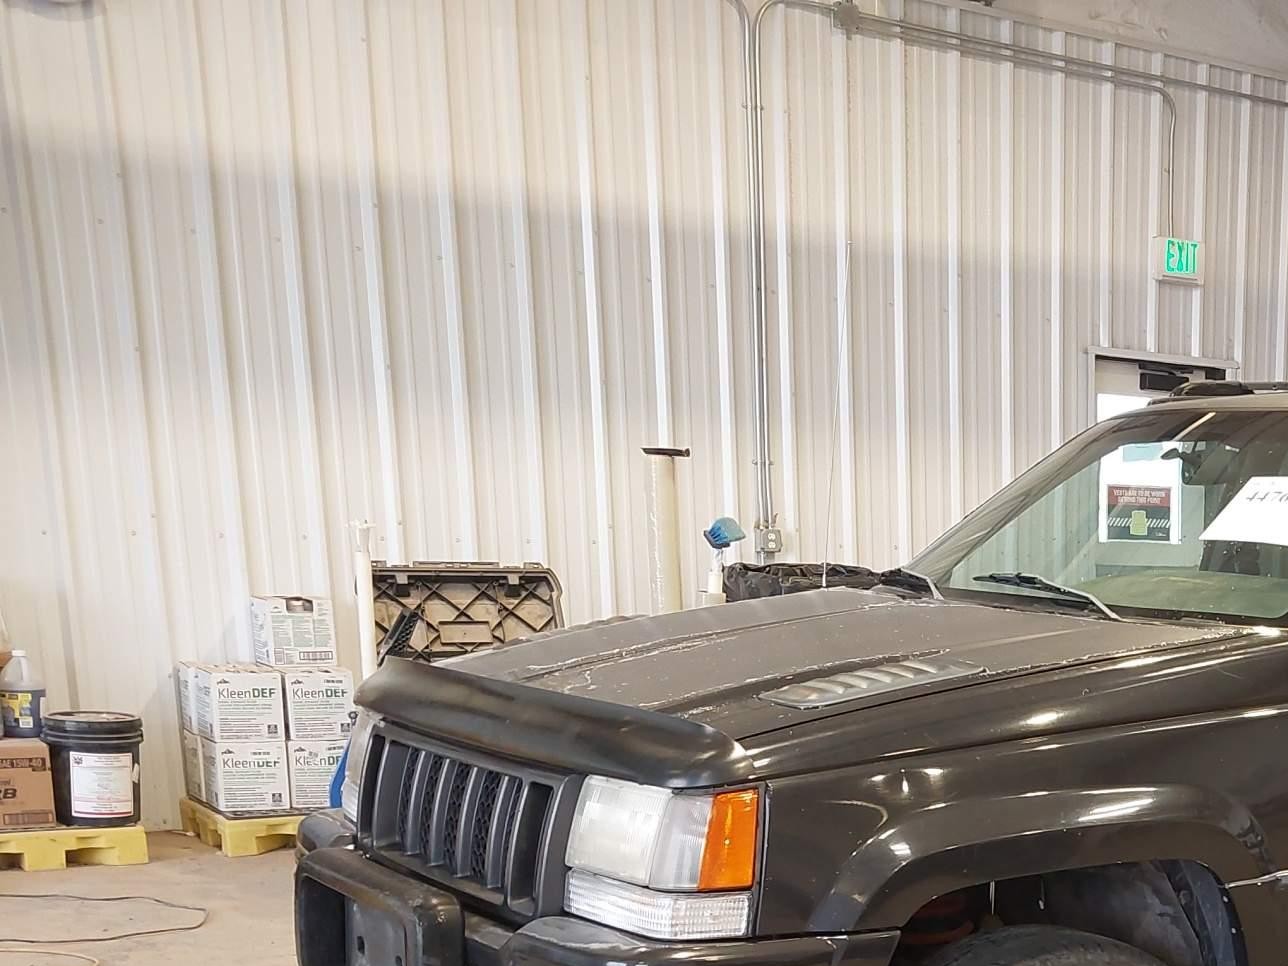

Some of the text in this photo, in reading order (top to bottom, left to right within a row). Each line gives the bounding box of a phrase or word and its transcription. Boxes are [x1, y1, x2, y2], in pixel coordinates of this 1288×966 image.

[1166, 239, 1199, 274] EXIT
[217, 688, 276, 699] KleenDEF
[292, 687, 348, 700] KleenDEF
